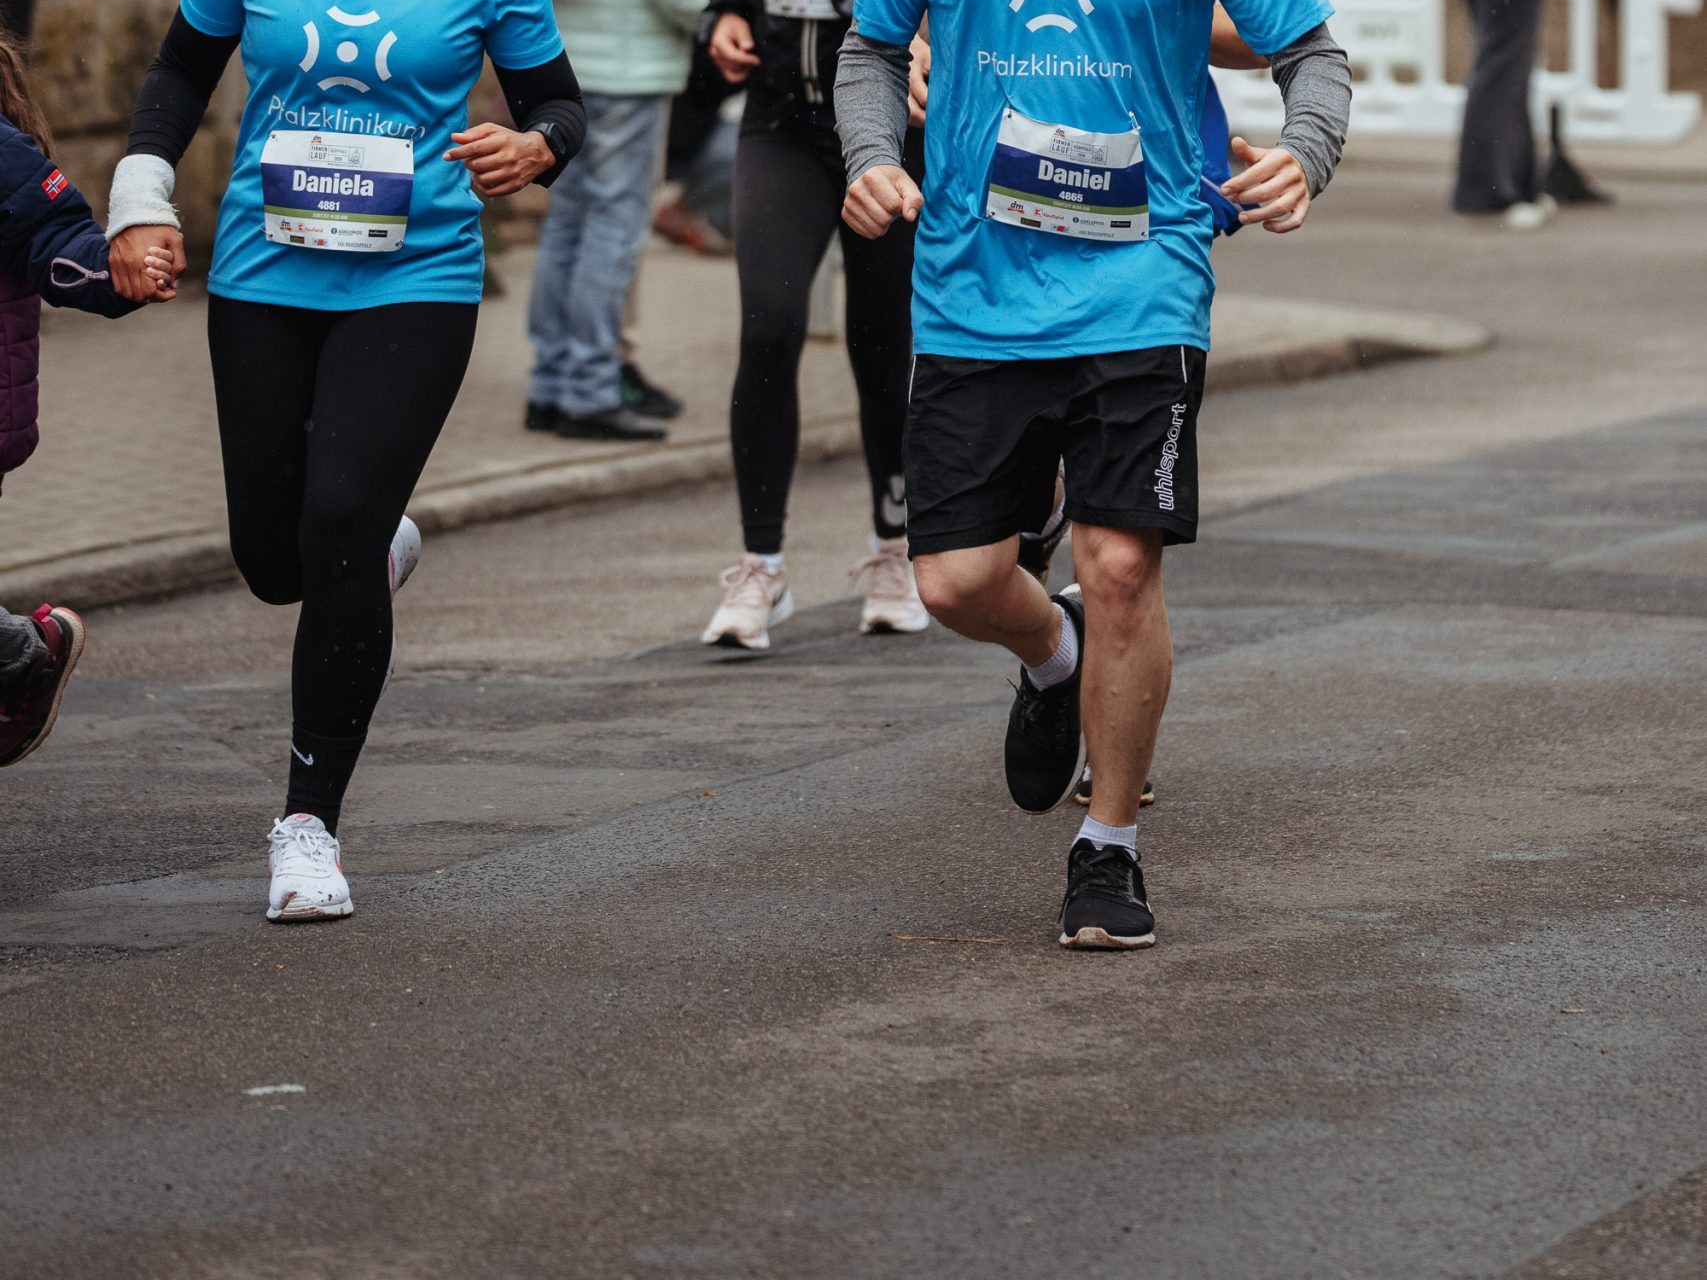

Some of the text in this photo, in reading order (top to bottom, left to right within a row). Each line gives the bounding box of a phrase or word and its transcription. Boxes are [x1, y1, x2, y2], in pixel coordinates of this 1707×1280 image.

[977, 50, 1132, 79] Pfalzklinikum
[268, 95, 426, 139] Pfalzklinikum
[1052, 144, 1069, 154] LAUF
[292, 169, 374, 197] Daniela
[1038, 159, 1111, 191] Daniel
[318, 200, 340, 211] 4881
[1010, 201, 1024, 210] dm
[1059, 191, 1084, 203] 4865
[1154, 403, 1187, 510] uhlsport
